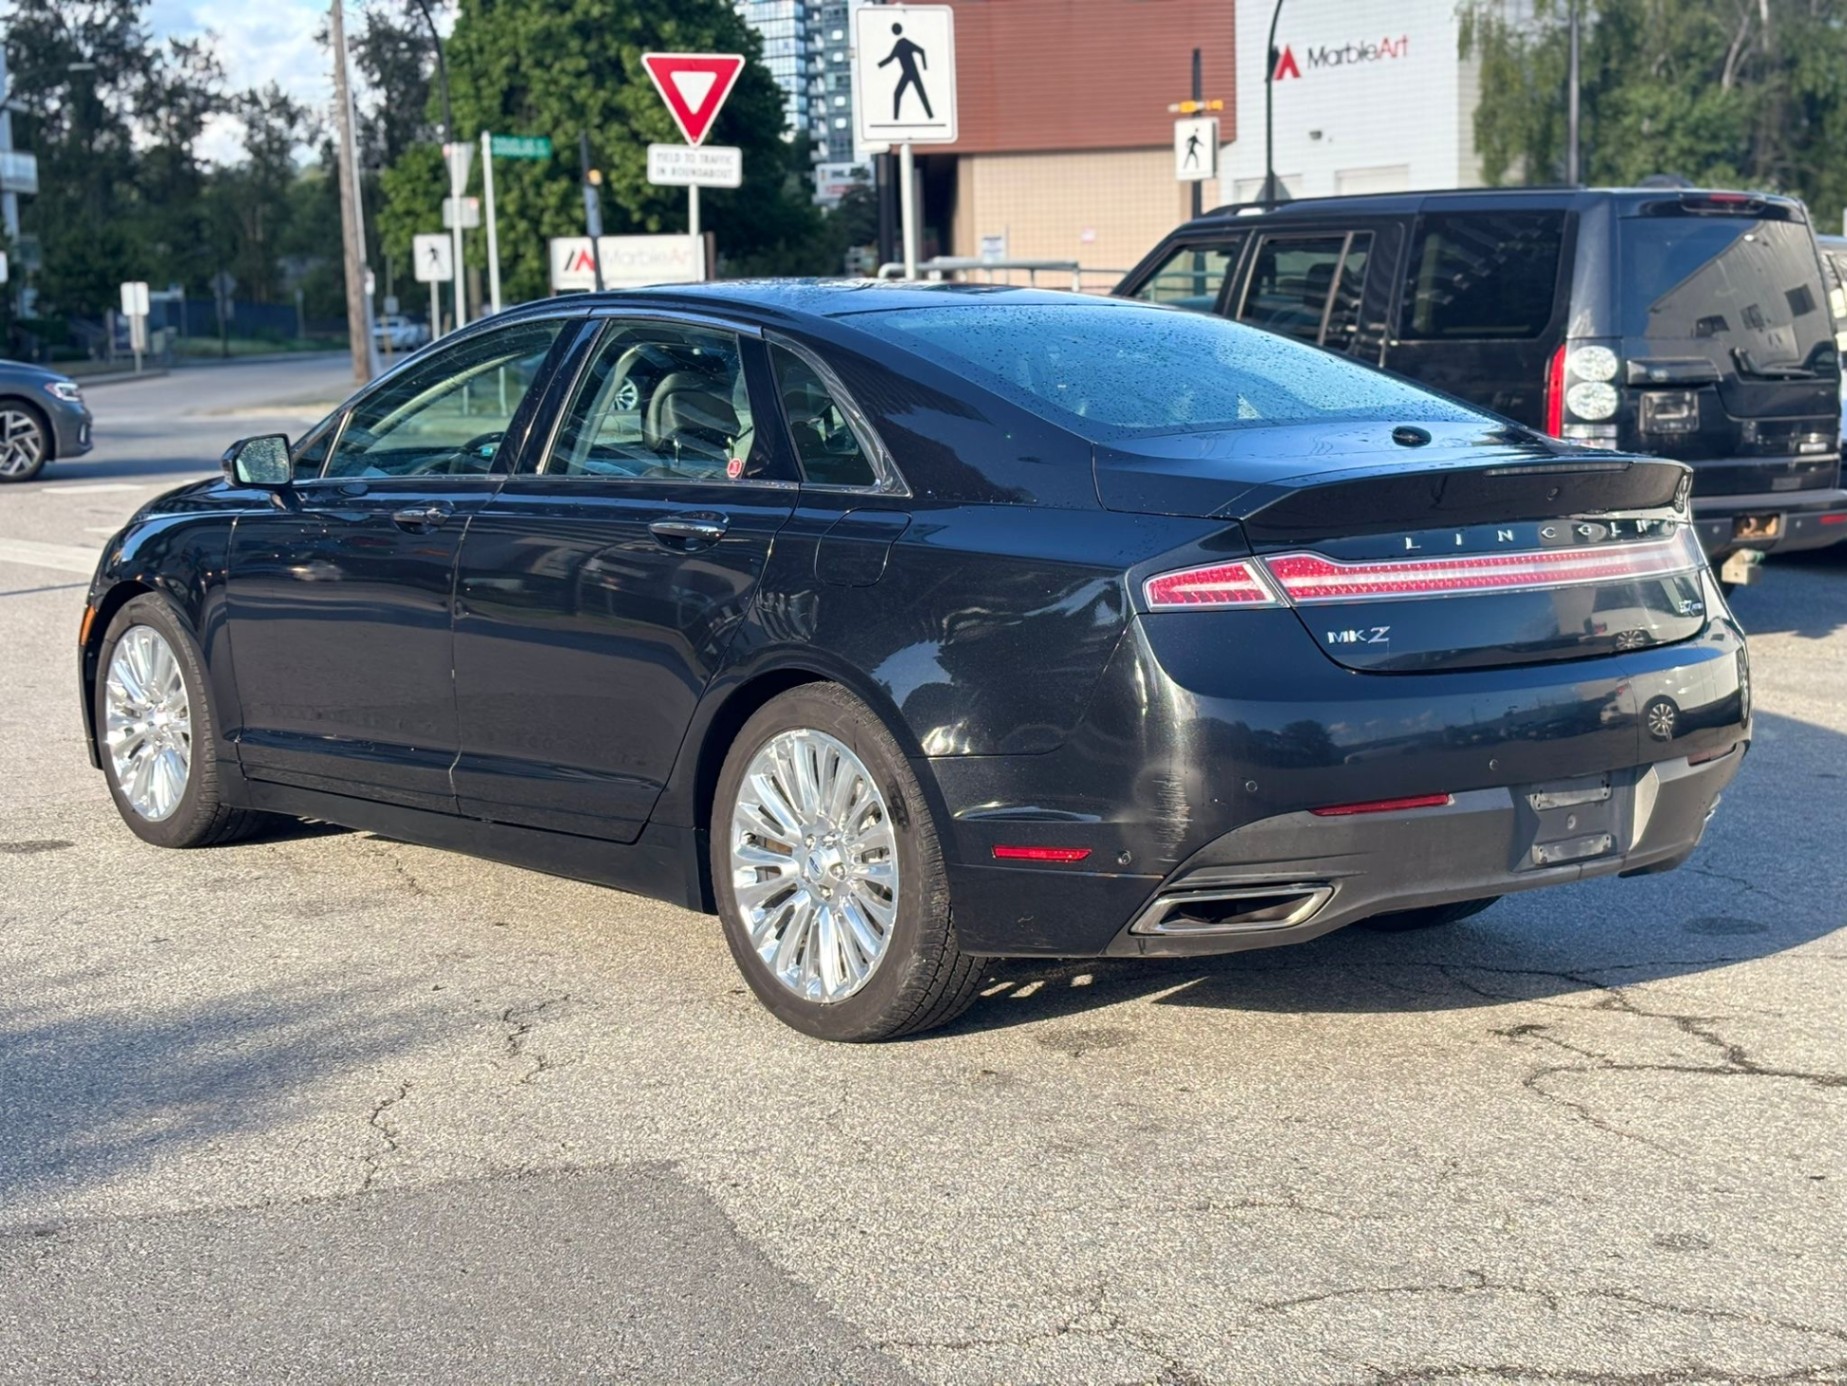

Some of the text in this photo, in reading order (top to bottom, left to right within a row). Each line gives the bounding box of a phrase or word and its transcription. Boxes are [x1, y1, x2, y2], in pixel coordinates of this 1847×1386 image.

[1307, 35, 1408, 69] MarbleArt
[656, 152, 735, 165] YIELD TO TRAFFIC
[1404, 519, 1659, 551] LINCOLN
[1327, 625, 1391, 644] MKZ
